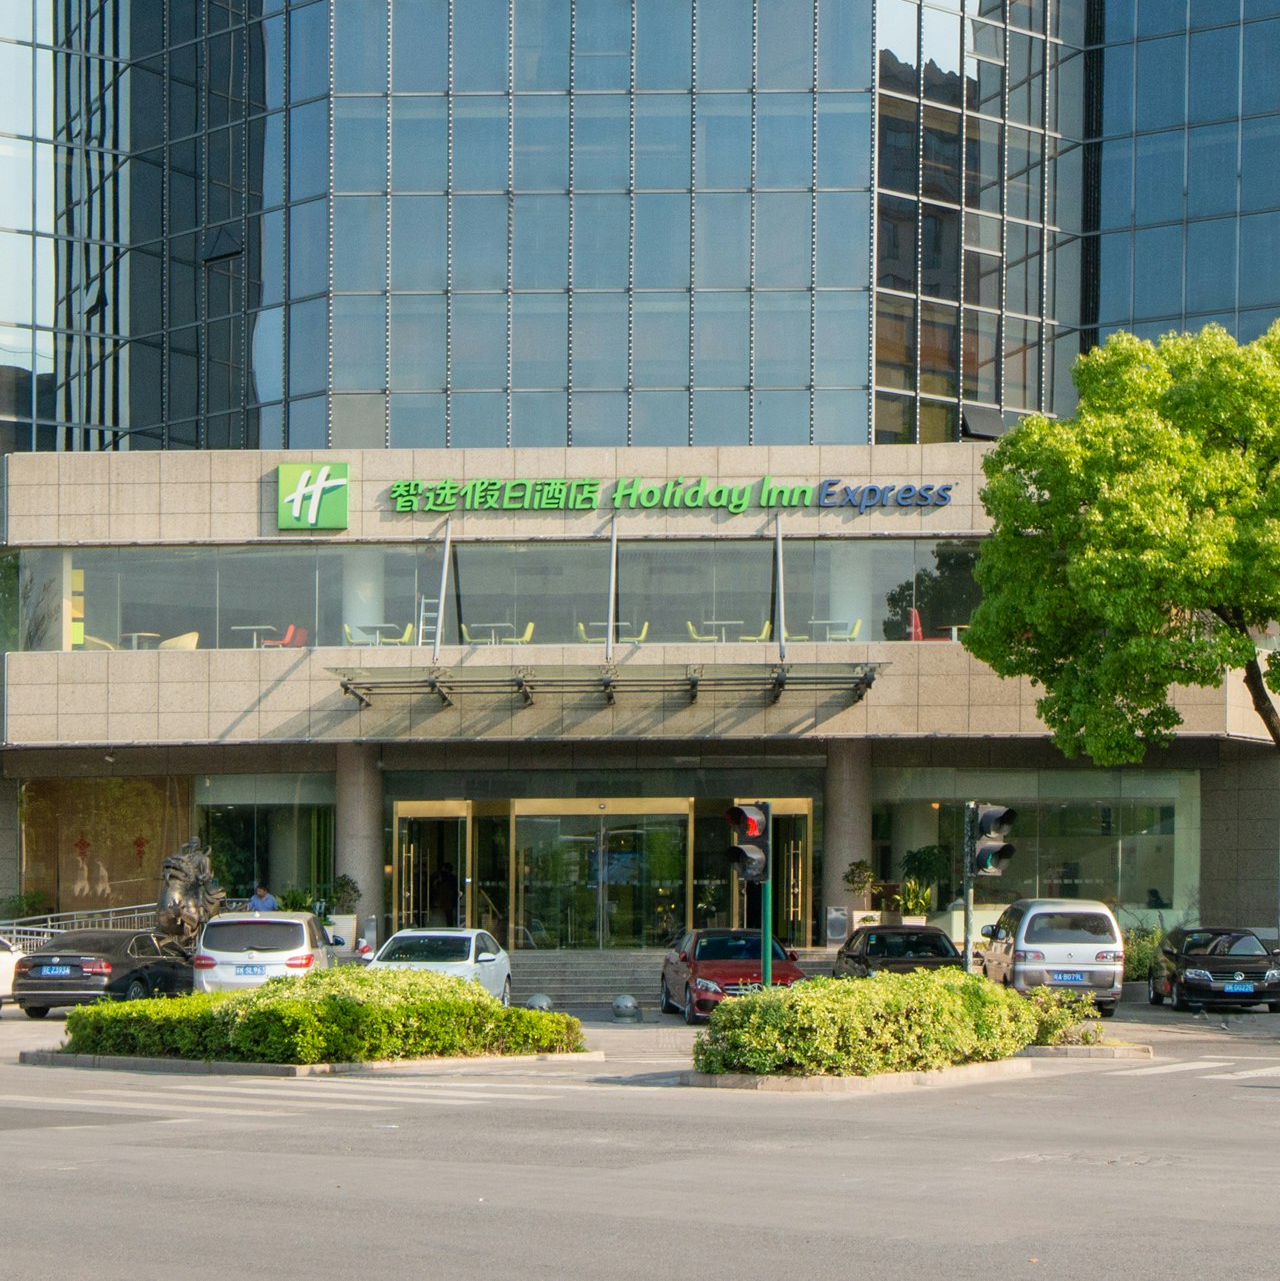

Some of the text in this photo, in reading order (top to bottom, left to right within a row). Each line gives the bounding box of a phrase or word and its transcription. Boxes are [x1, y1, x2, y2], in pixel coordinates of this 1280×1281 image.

[390, 475, 953, 514] 智选假日酒店 Holiday Inn Express
